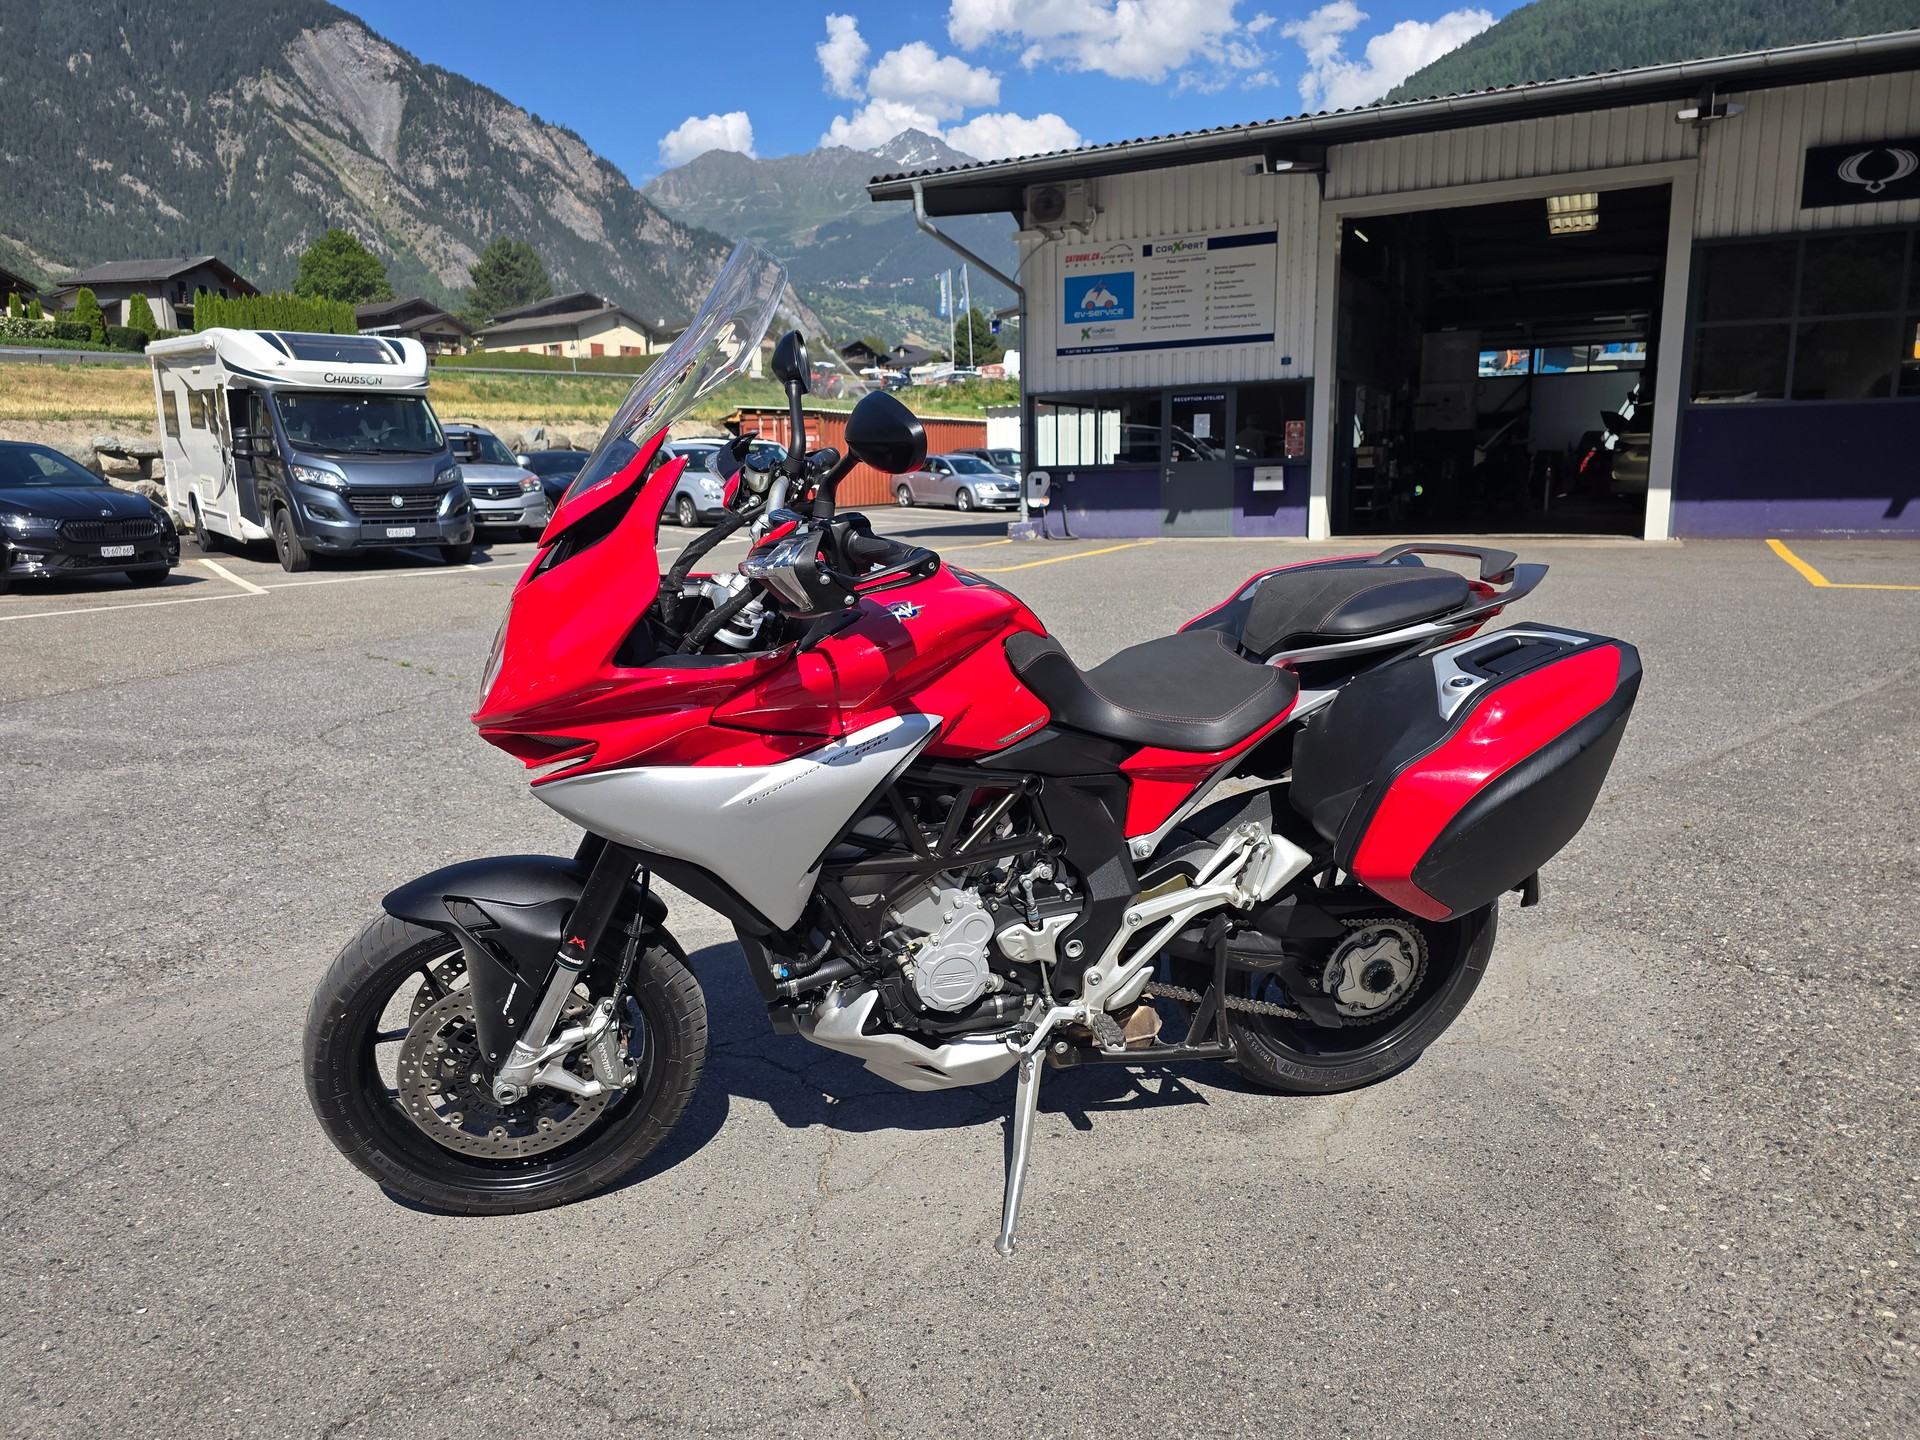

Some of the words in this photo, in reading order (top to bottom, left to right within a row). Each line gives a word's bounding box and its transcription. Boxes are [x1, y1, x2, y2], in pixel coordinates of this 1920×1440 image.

[1074, 308, 1124, 318] ev-service
[323, 372, 383, 385] CHAUSSON
[743, 765, 821, 806] TURISMO
[820, 731, 889, 765] VELOCE
[597, 1041, 614, 1080] brembo
